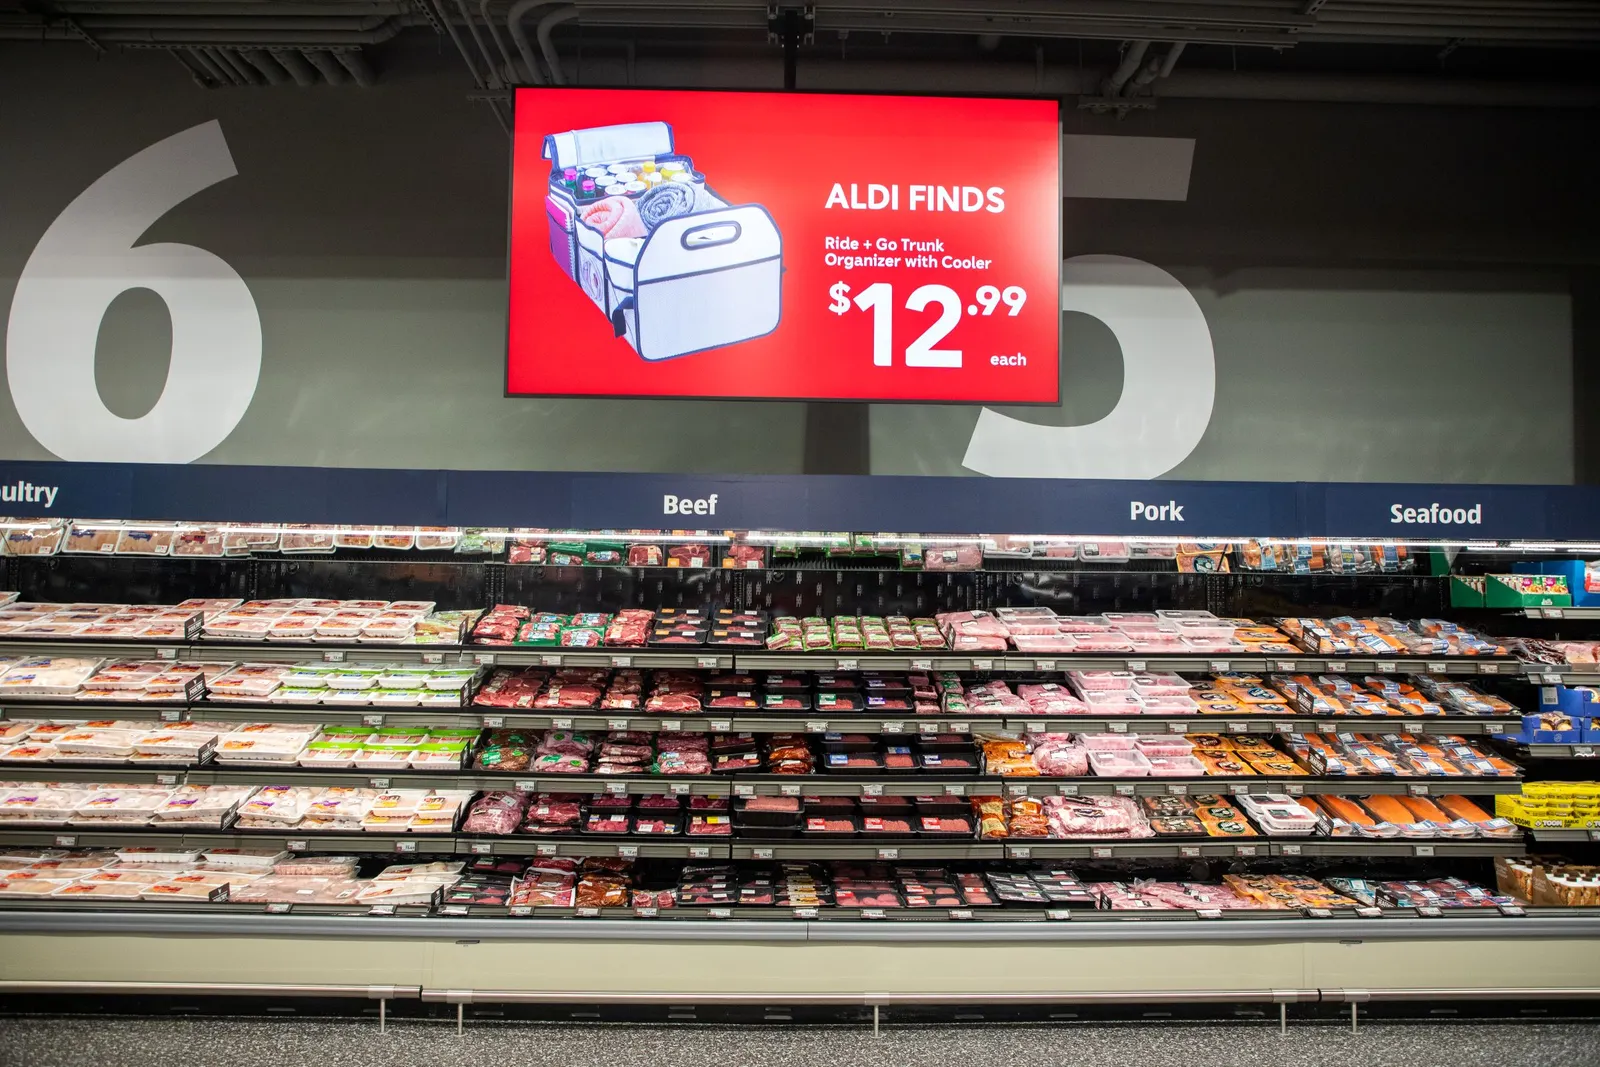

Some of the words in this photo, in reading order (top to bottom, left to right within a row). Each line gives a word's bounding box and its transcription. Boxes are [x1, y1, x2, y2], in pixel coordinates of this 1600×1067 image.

[824, 183, 898, 211] ALDI
[908, 184, 1006, 214] FINDS
[824, 236, 859, 250] Ride
[876, 237, 898, 251] Go
[900, 238, 945, 252] Trunk
[824, 253, 901, 270] Organizer
[904, 255, 938, 268] with
[941, 255, 992, 269] Cooler
[6, 119, 262, 464] 6
[989, 352, 1027, 367] each
[0, 480, 59, 508] ultry
[663, 493, 719, 516] Beef
[1129, 500, 1185, 522] Pork
[1390, 502, 1482, 525] Seafood
